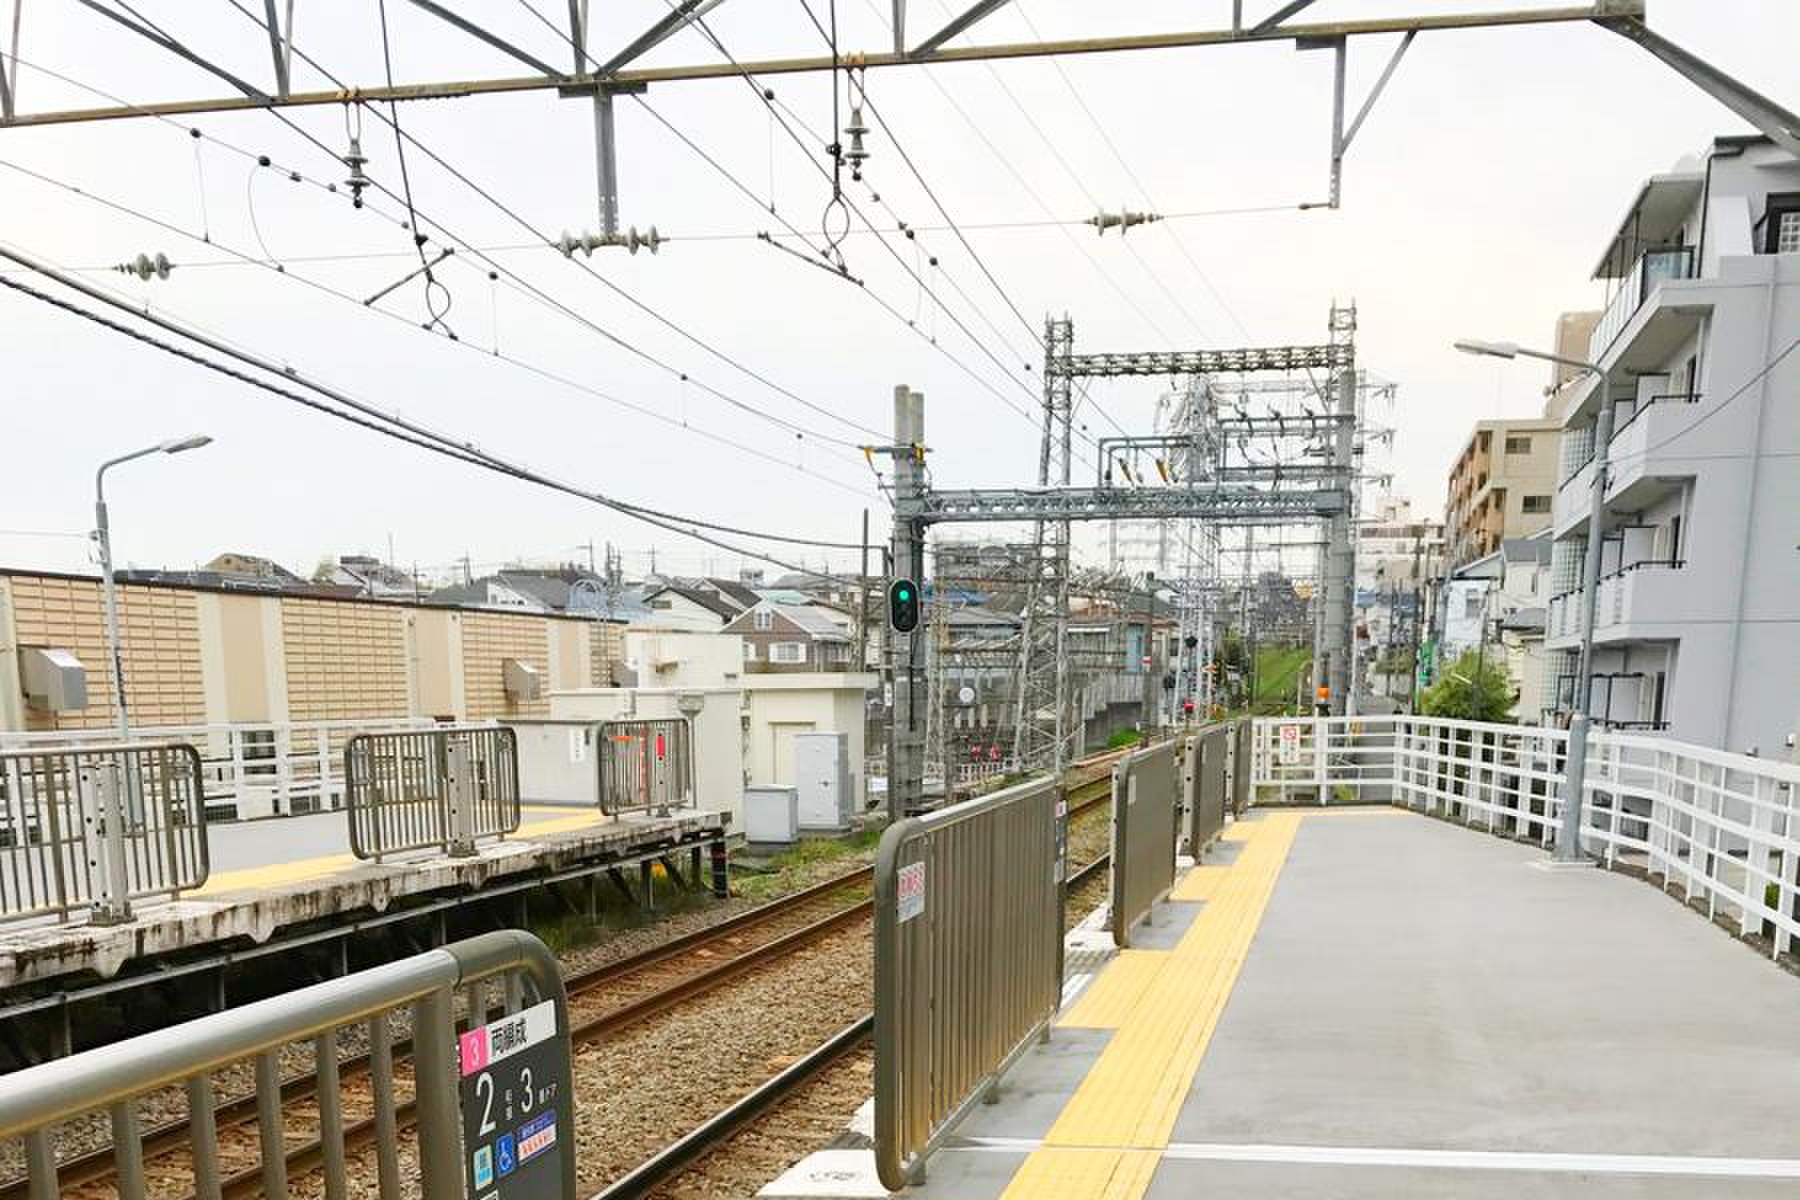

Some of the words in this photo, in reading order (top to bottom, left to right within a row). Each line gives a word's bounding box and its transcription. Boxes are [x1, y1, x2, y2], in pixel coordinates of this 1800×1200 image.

[470, 1036, 481, 1067] 3
[476, 1071, 497, 1137] 2
[520, 1067, 534, 1113] 3
